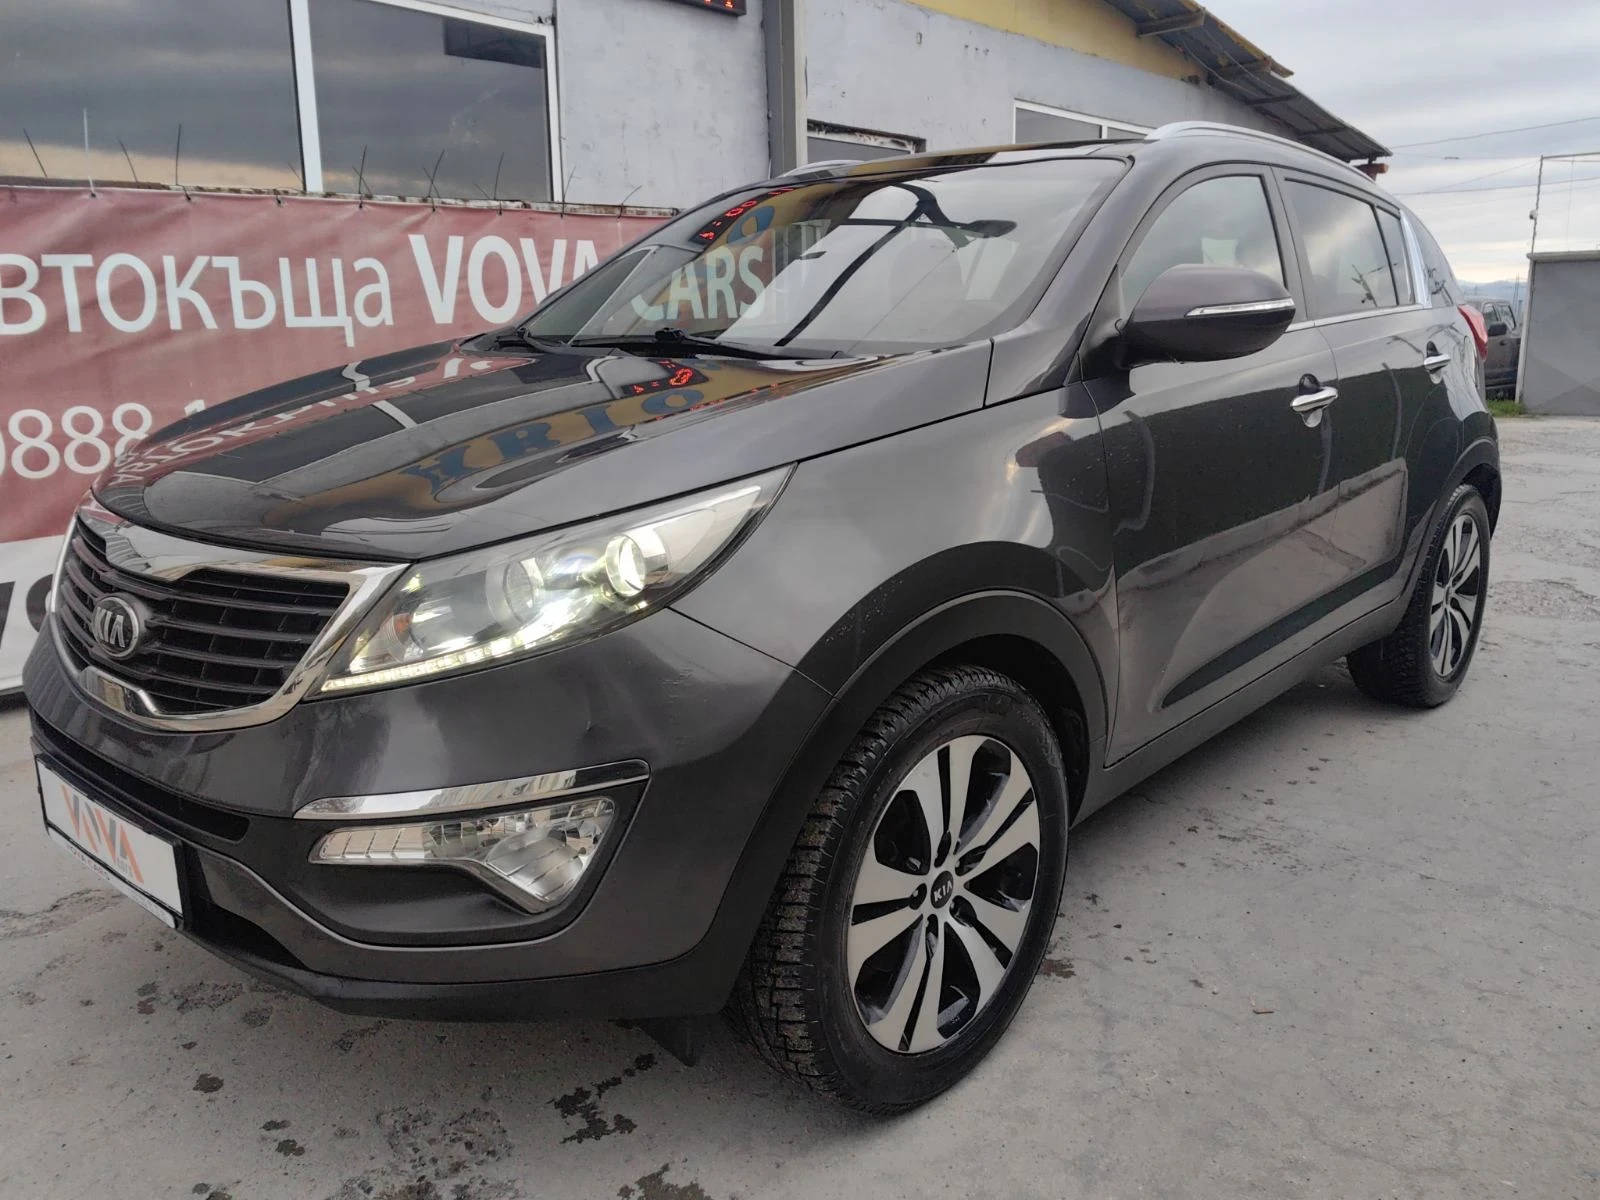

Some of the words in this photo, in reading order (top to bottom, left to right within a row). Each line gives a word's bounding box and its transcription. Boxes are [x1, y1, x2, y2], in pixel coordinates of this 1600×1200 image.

[0, 402, 152, 479] 888
[94, 606, 126, 648] KIA
[934, 880, 953, 902] KIA
